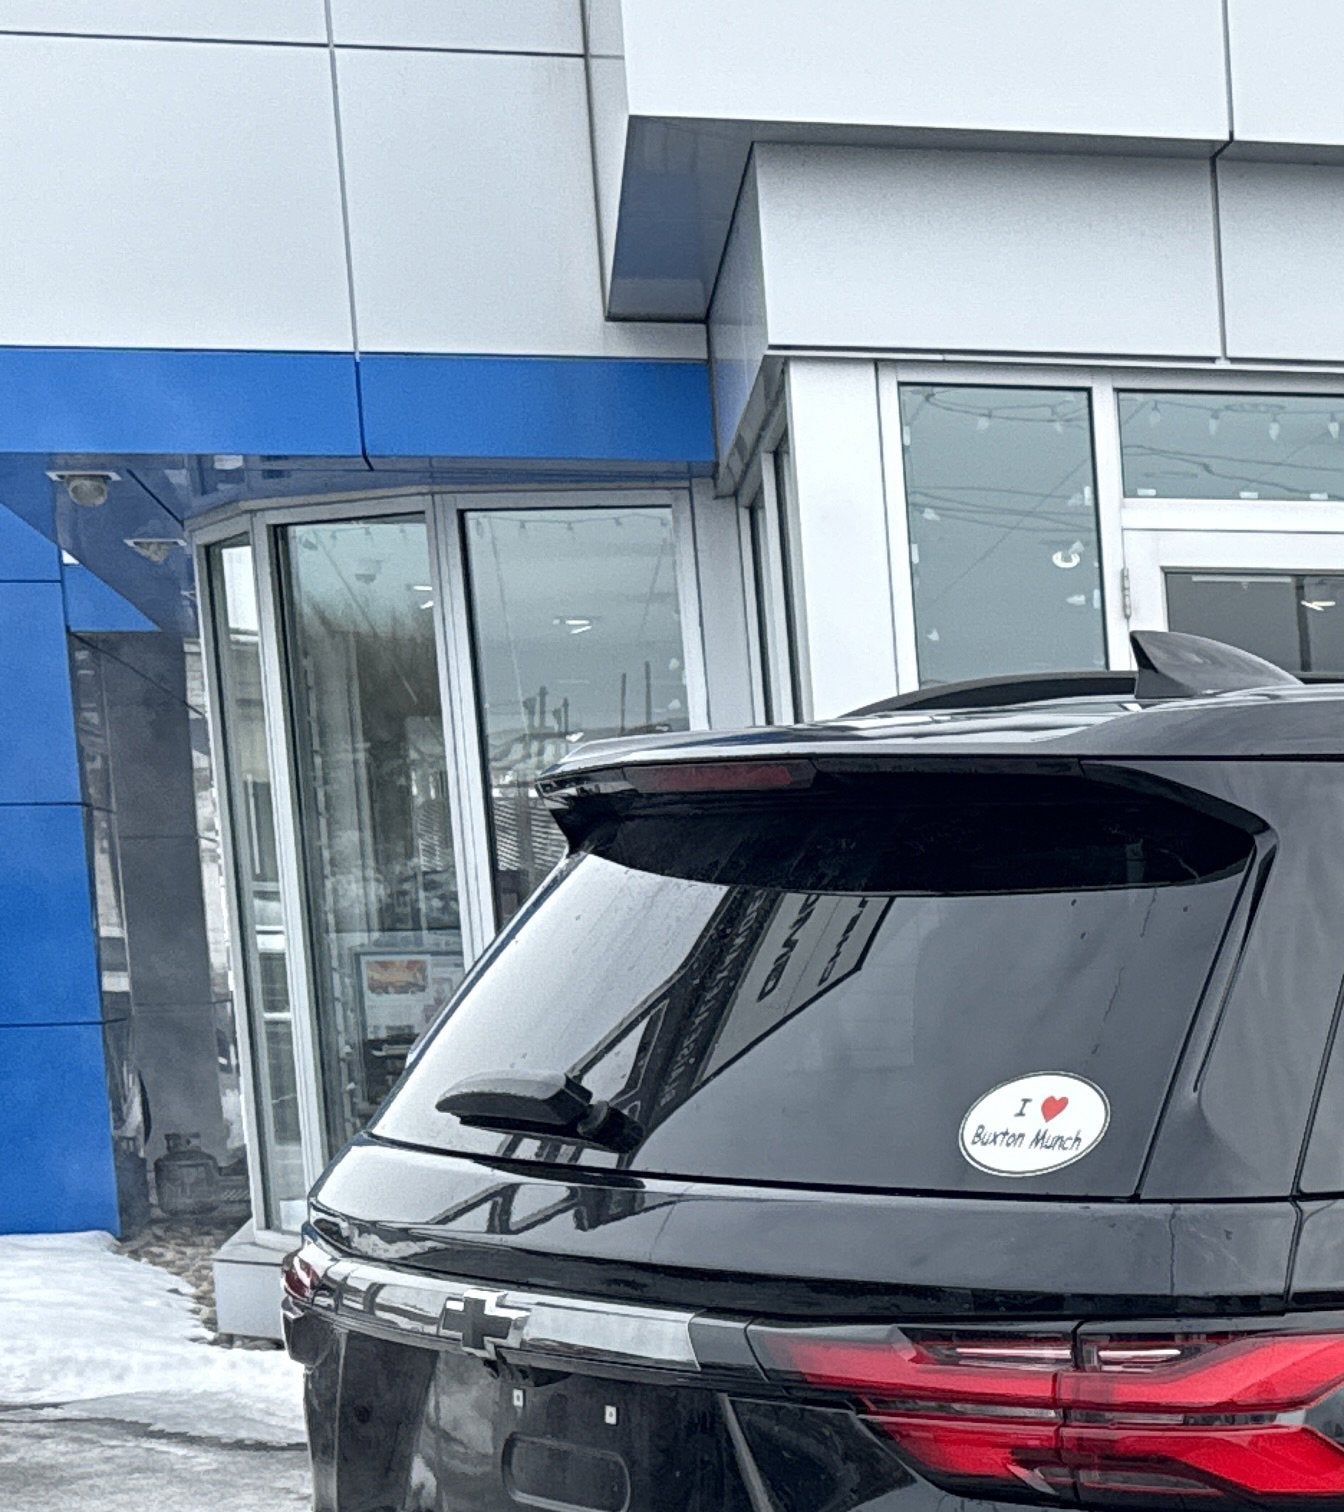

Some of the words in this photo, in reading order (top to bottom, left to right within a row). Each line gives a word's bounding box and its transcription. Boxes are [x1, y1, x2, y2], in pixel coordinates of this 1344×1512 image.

[1013, 1098, 1032, 1117] I
[971, 1123, 1025, 1149] Buxton
[1028, 1127, 1082, 1151] Munch
